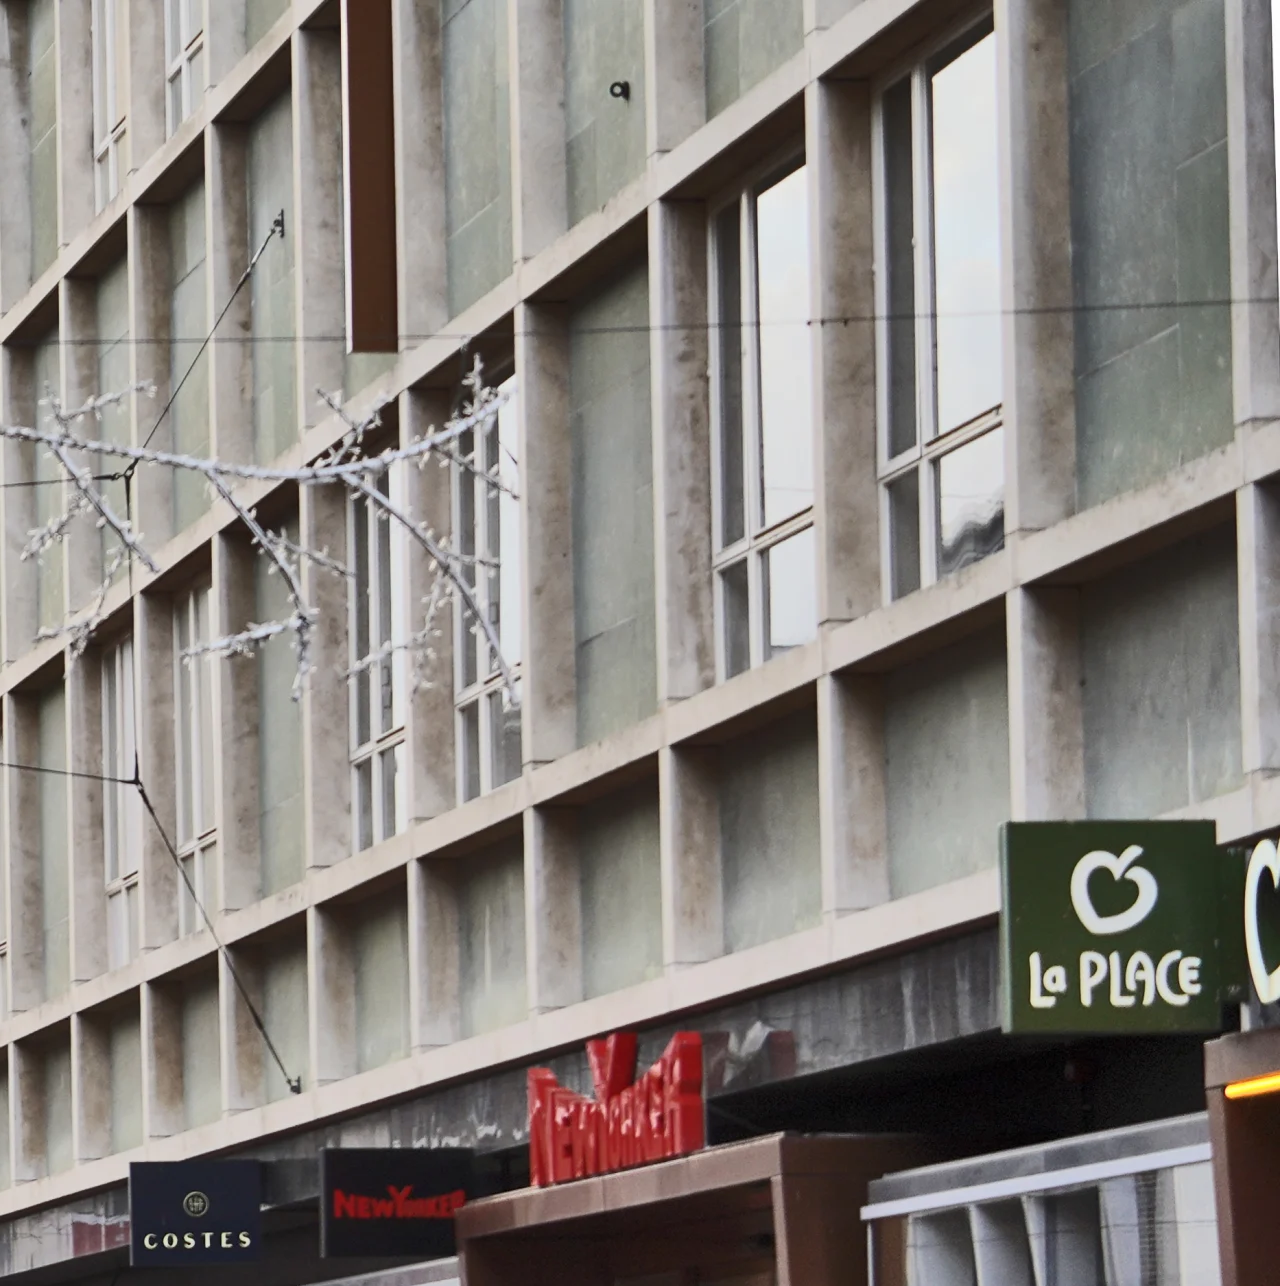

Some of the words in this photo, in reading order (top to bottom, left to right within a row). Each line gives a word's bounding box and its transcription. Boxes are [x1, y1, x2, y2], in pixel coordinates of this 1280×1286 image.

[1029, 952, 1067, 1008] La
[1080, 950, 1201, 1007] PLACE
[144, 1232, 251, 1249] COSTES
